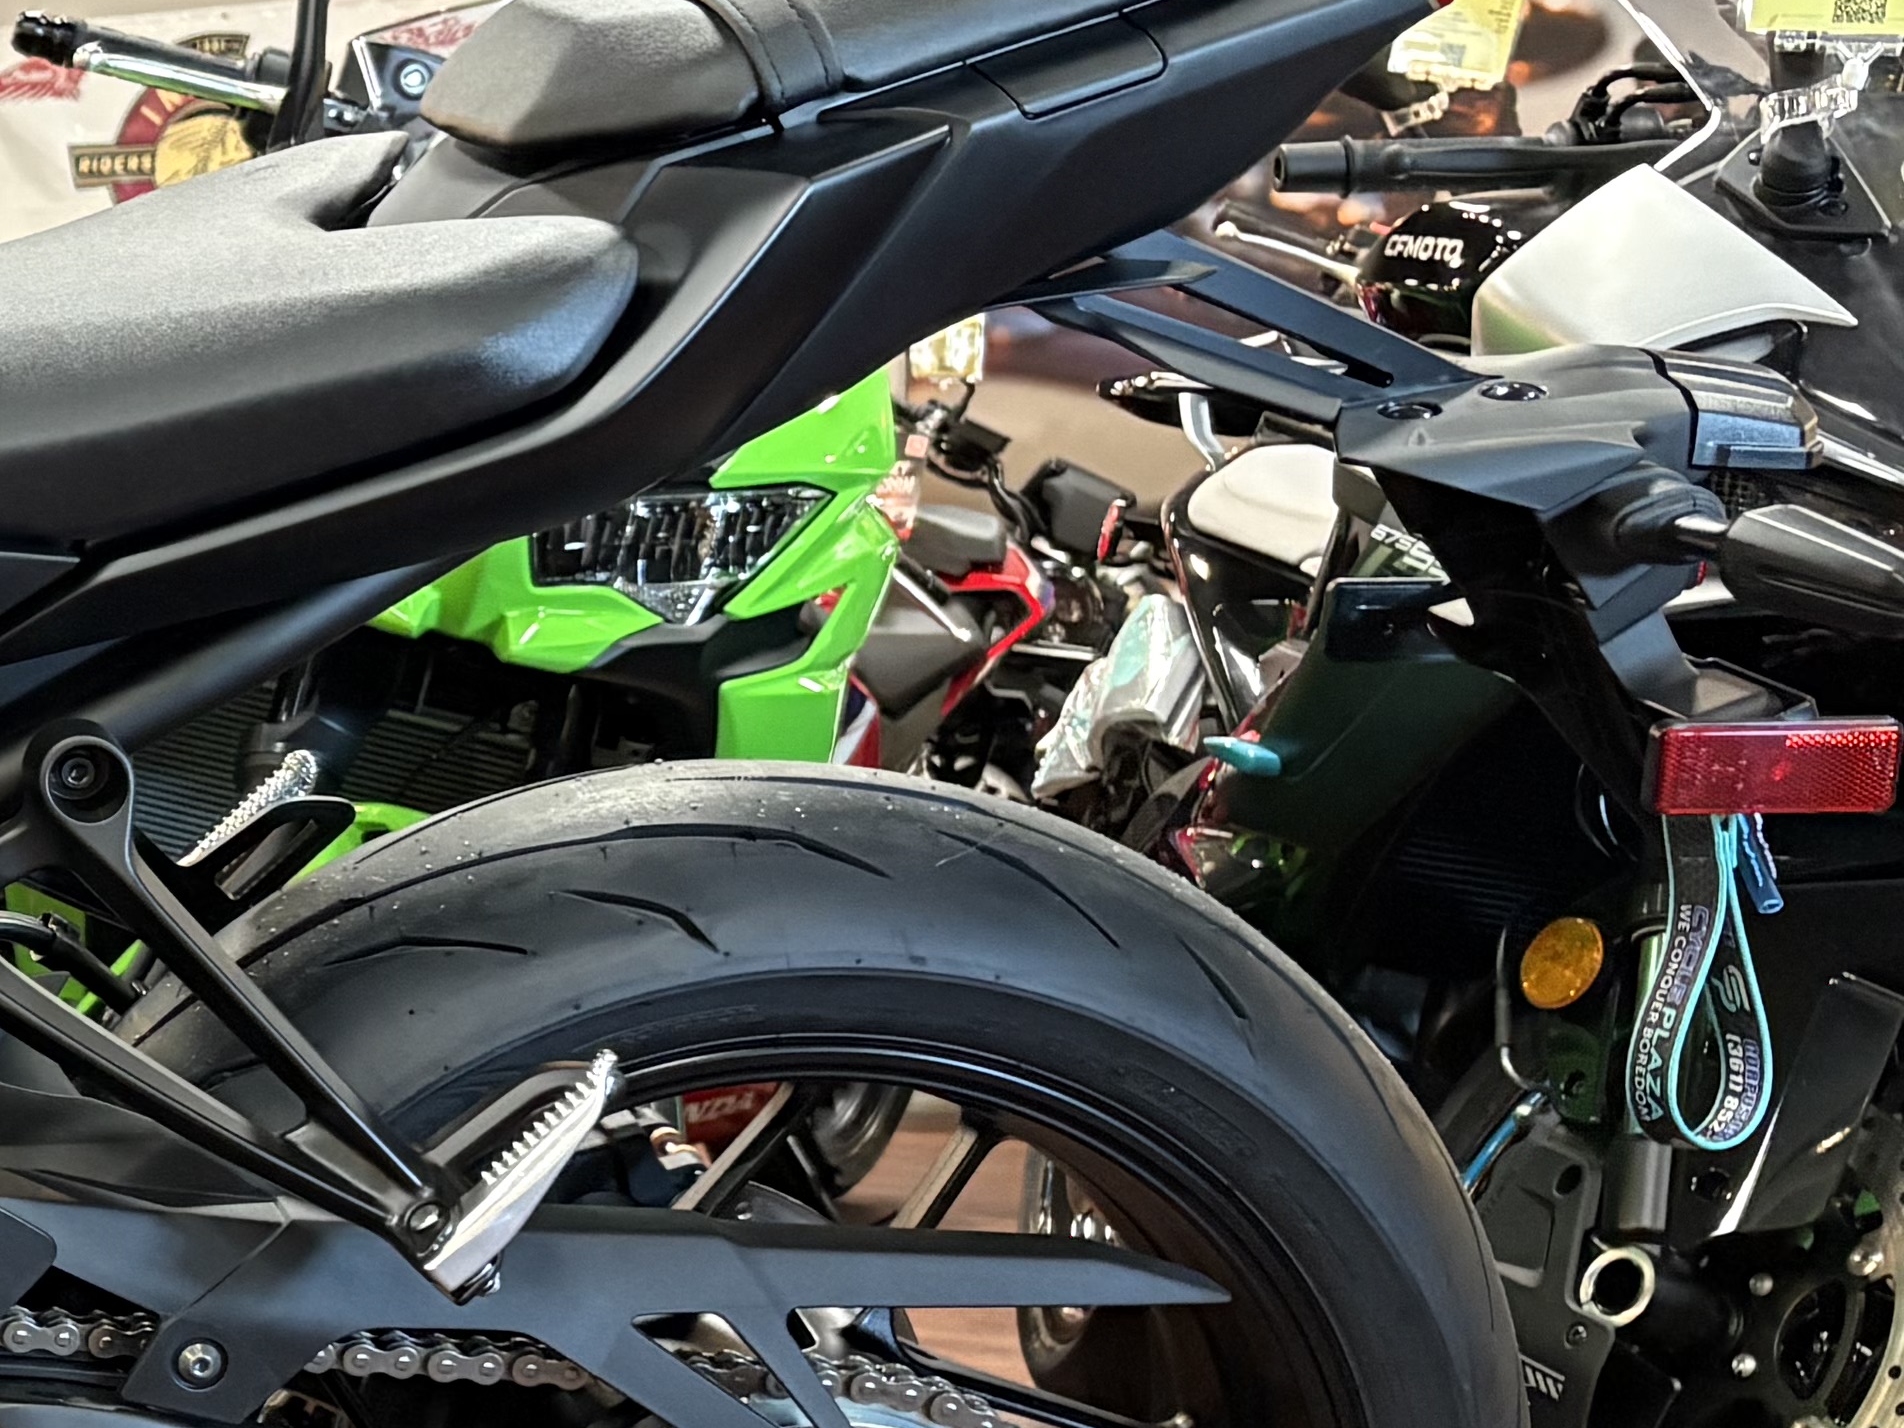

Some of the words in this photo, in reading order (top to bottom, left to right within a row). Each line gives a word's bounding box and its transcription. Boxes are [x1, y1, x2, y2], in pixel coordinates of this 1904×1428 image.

[1384, 234, 1464, 262] CFMOTO
[1667, 905, 1709, 1005] CYCLE
[1677, 904, 1692, 932] WE
[1647, 936, 1687, 1023] CONQUER
[1646, 1007, 1678, 1121] PLAZA
